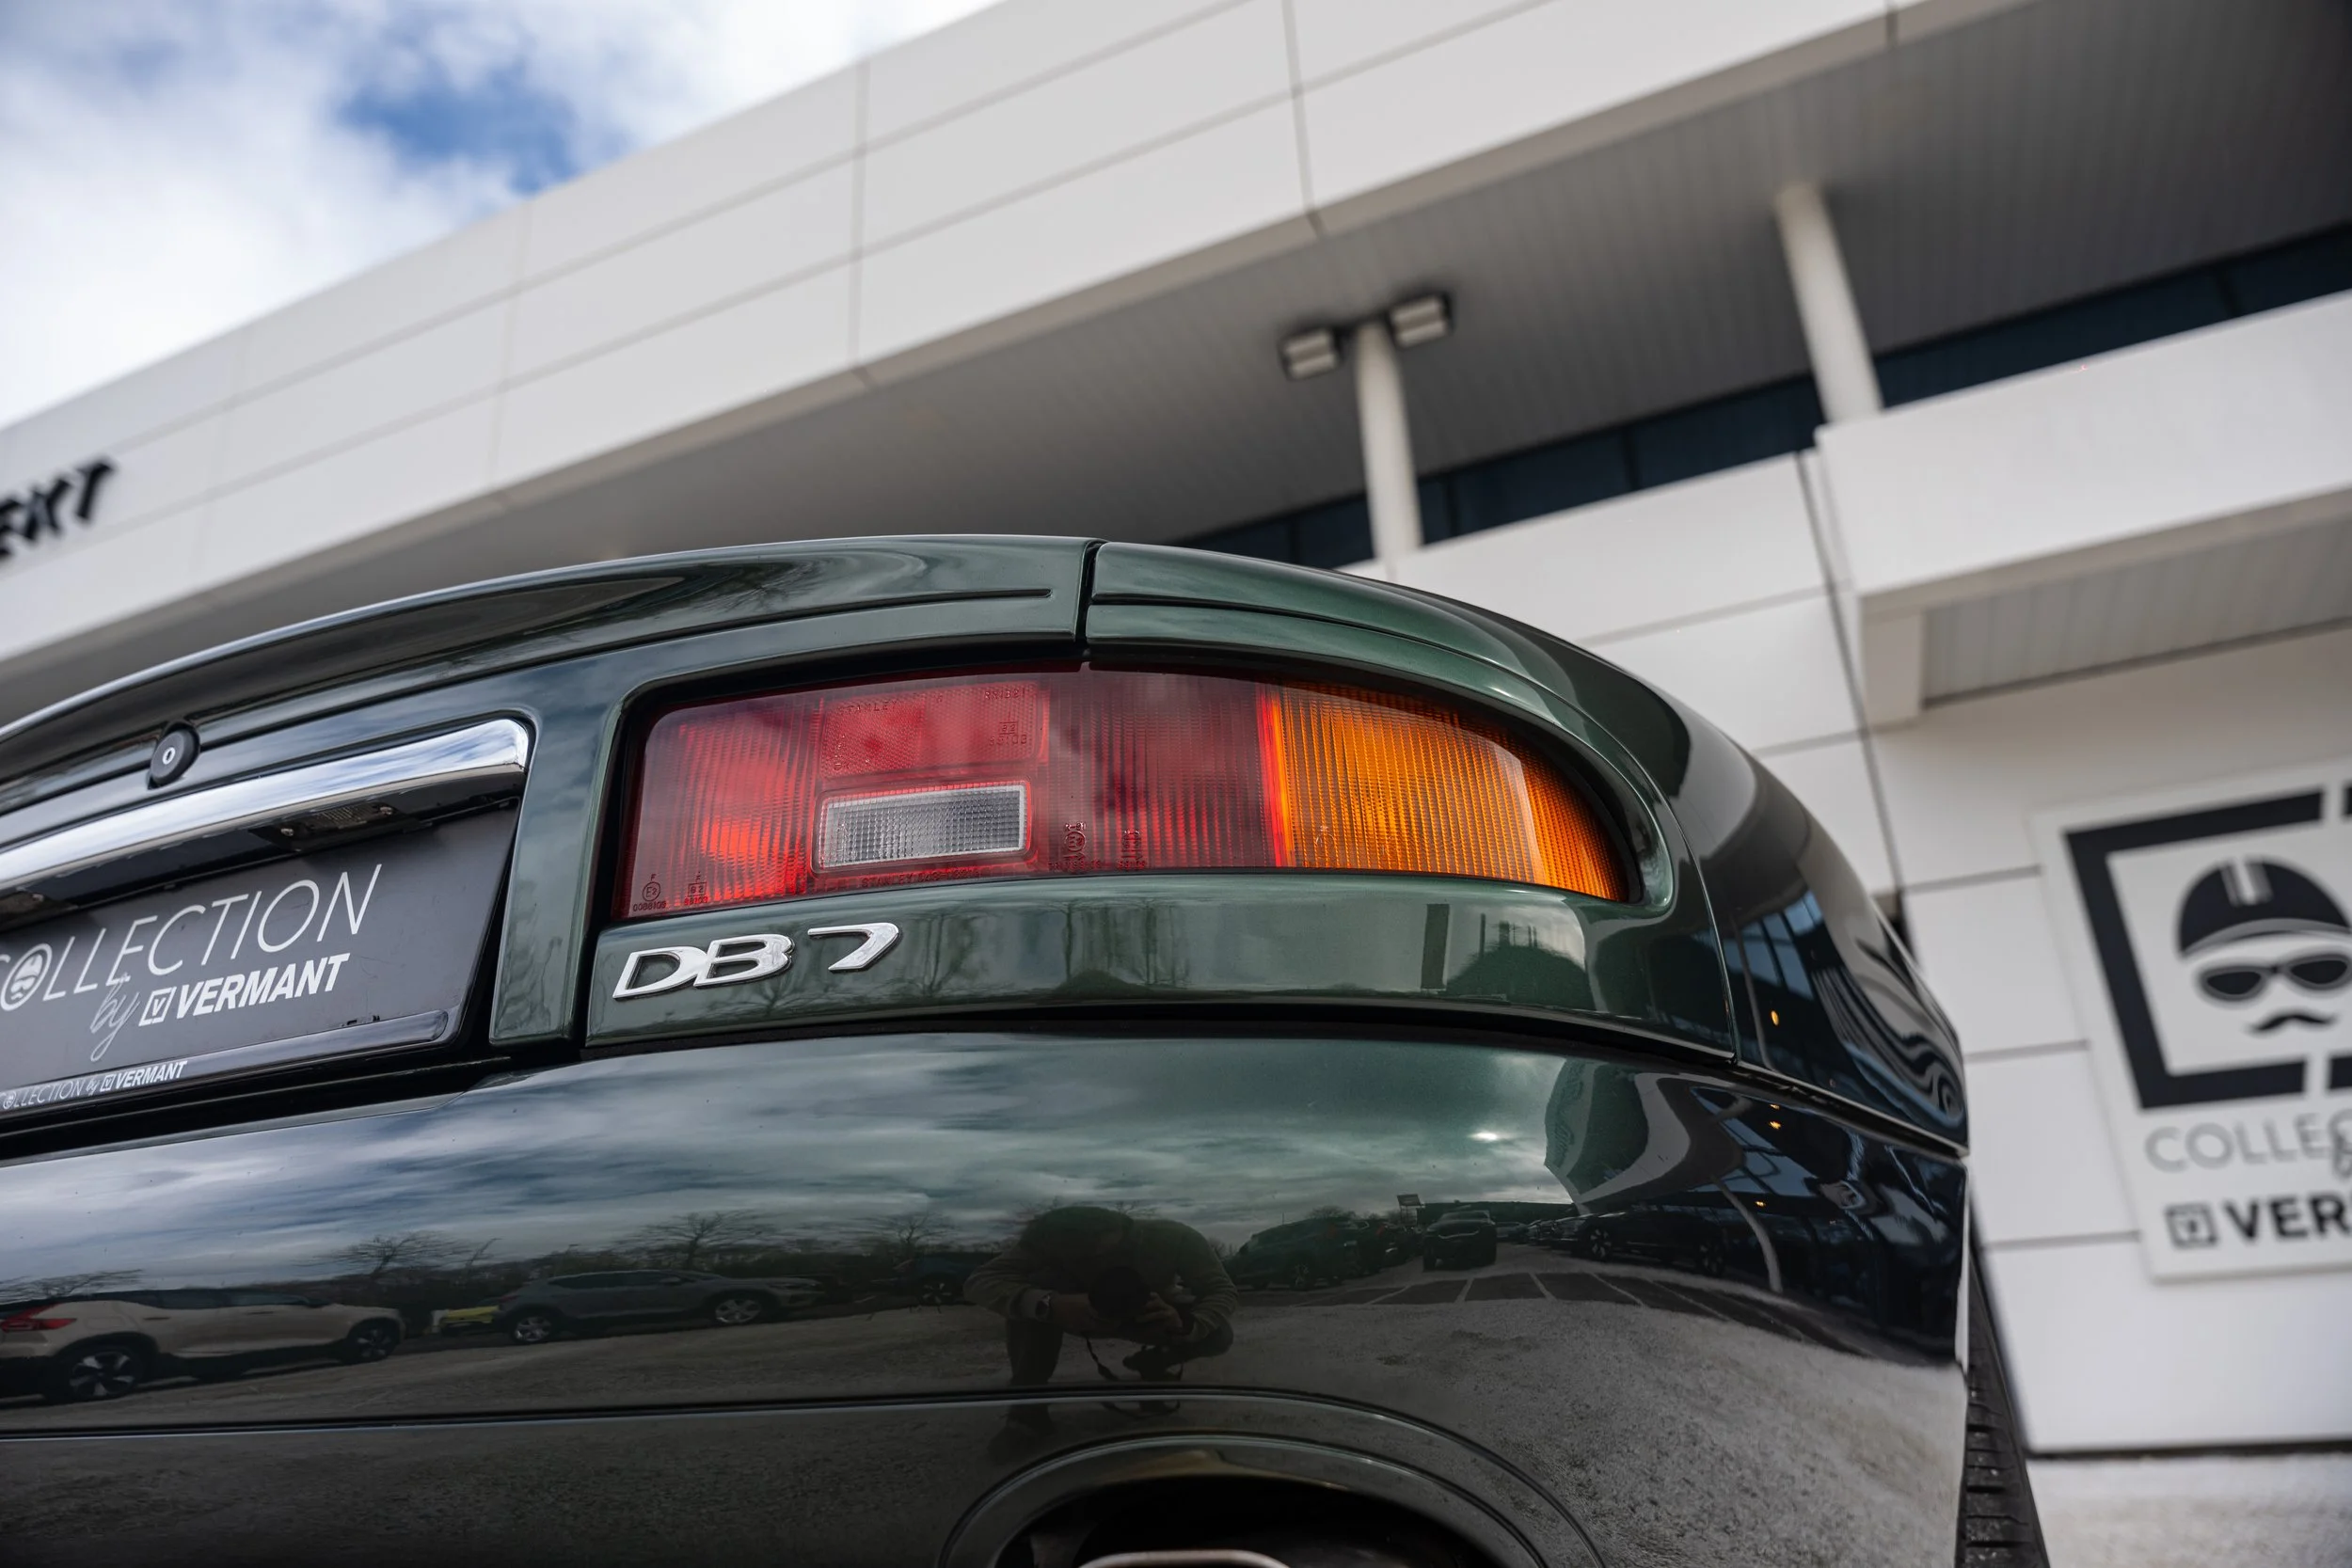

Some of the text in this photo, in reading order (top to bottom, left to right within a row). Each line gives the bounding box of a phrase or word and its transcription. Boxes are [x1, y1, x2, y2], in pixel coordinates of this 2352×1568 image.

[0, 863, 382, 1012] OLLECTION
[89, 971, 141, 1062] by
[176, 952, 351, 1020] VERMANT
[0, 1080, 85, 1110] OLLECTION
[116, 1060, 188, 1090] VERMANT
